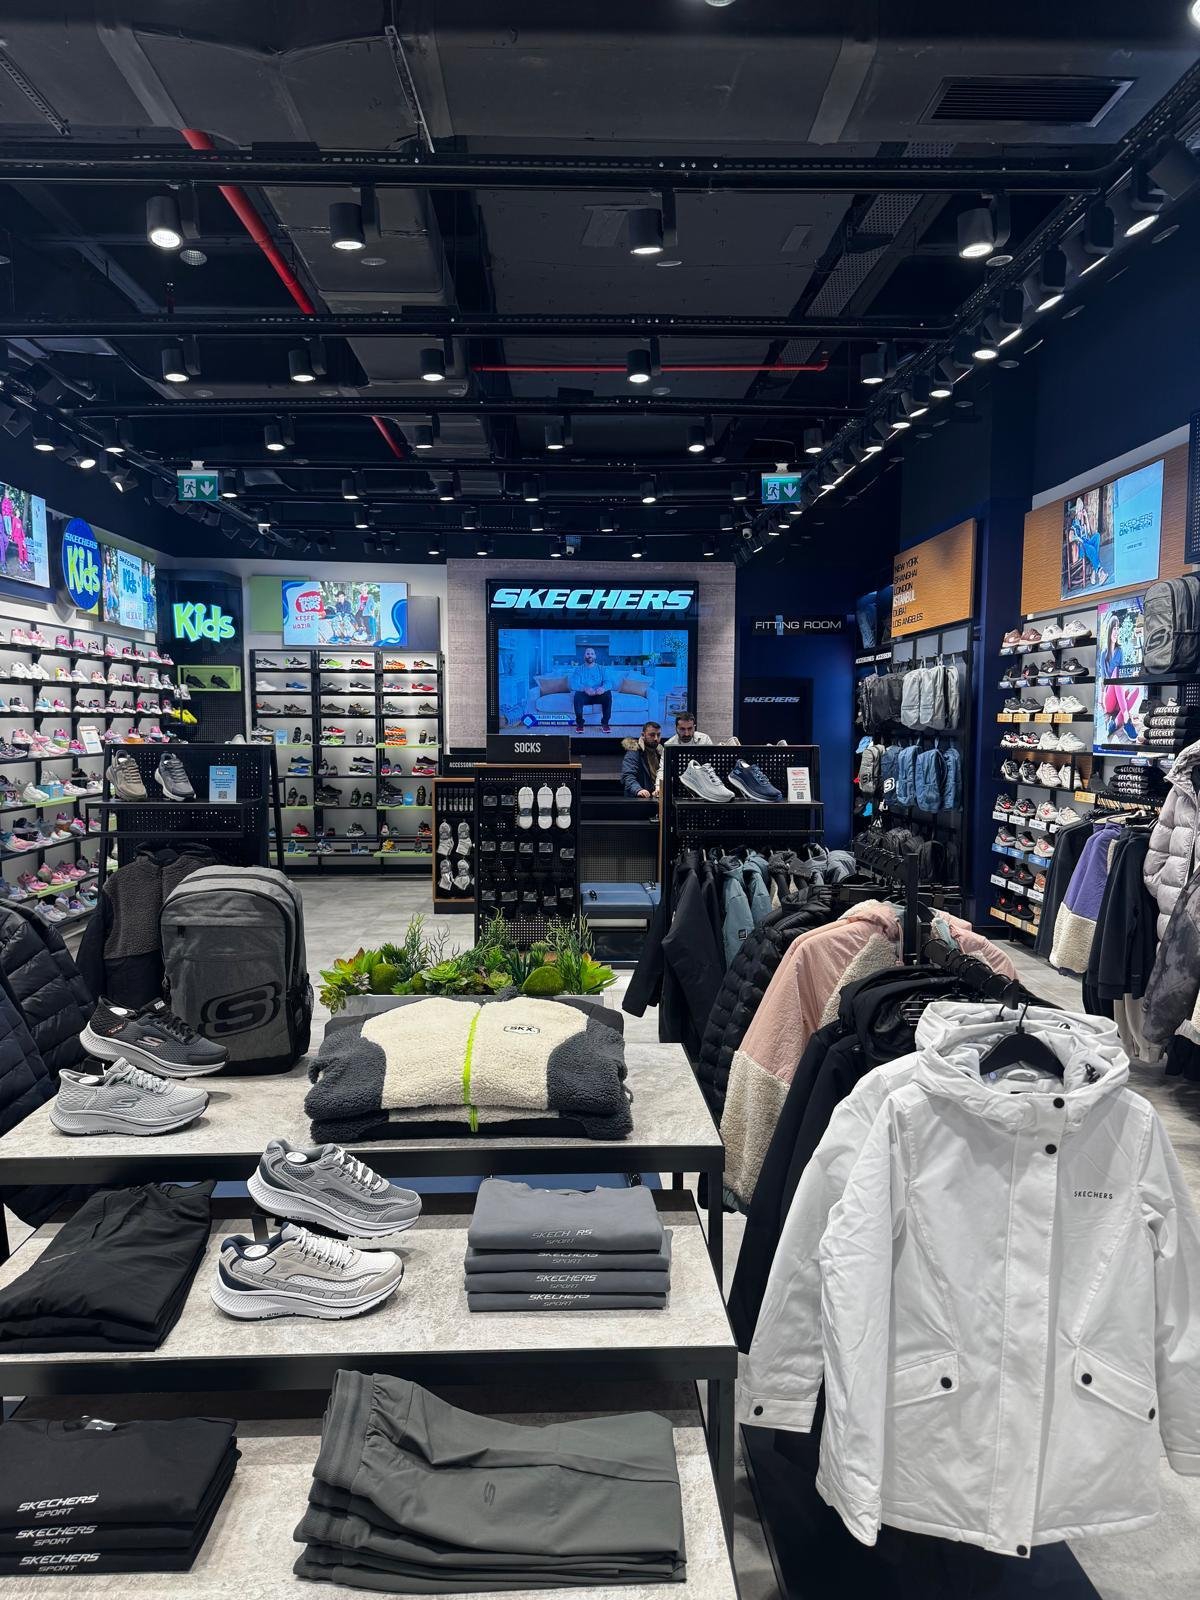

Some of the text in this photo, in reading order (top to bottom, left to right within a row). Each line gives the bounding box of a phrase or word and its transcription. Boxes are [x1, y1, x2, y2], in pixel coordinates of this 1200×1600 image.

[64, 532, 98, 550] SKECHERS
[905, 555, 919, 568] YORK
[66, 543, 100, 596] Kids
[893, 581, 913, 596] LONDON
[490, 588, 695, 610] SKECHERS
[173, 601, 236, 643] Kids
[755, 621, 842, 630] FITTING ROOM
[892, 612, 924, 629] LOS ANGELES
[514, 742, 541, 753] SOCKS
[1073, 1190, 1113, 1200] SKECHERS
[530, 1229, 593, 1240] SKECHRS
[535, 1274, 599, 1282] SKECHERS
[16, 1493, 99, 1512] SKECHERS
[34, 1507, 75, 1519] SPORT
[15, 1525, 99, 1539] SKECHERS
[32, 1537, 75, 1547] SPORT
[19, 1552, 101, 1566] SKECHERS
[38, 1564, 79, 1572] SPORT
